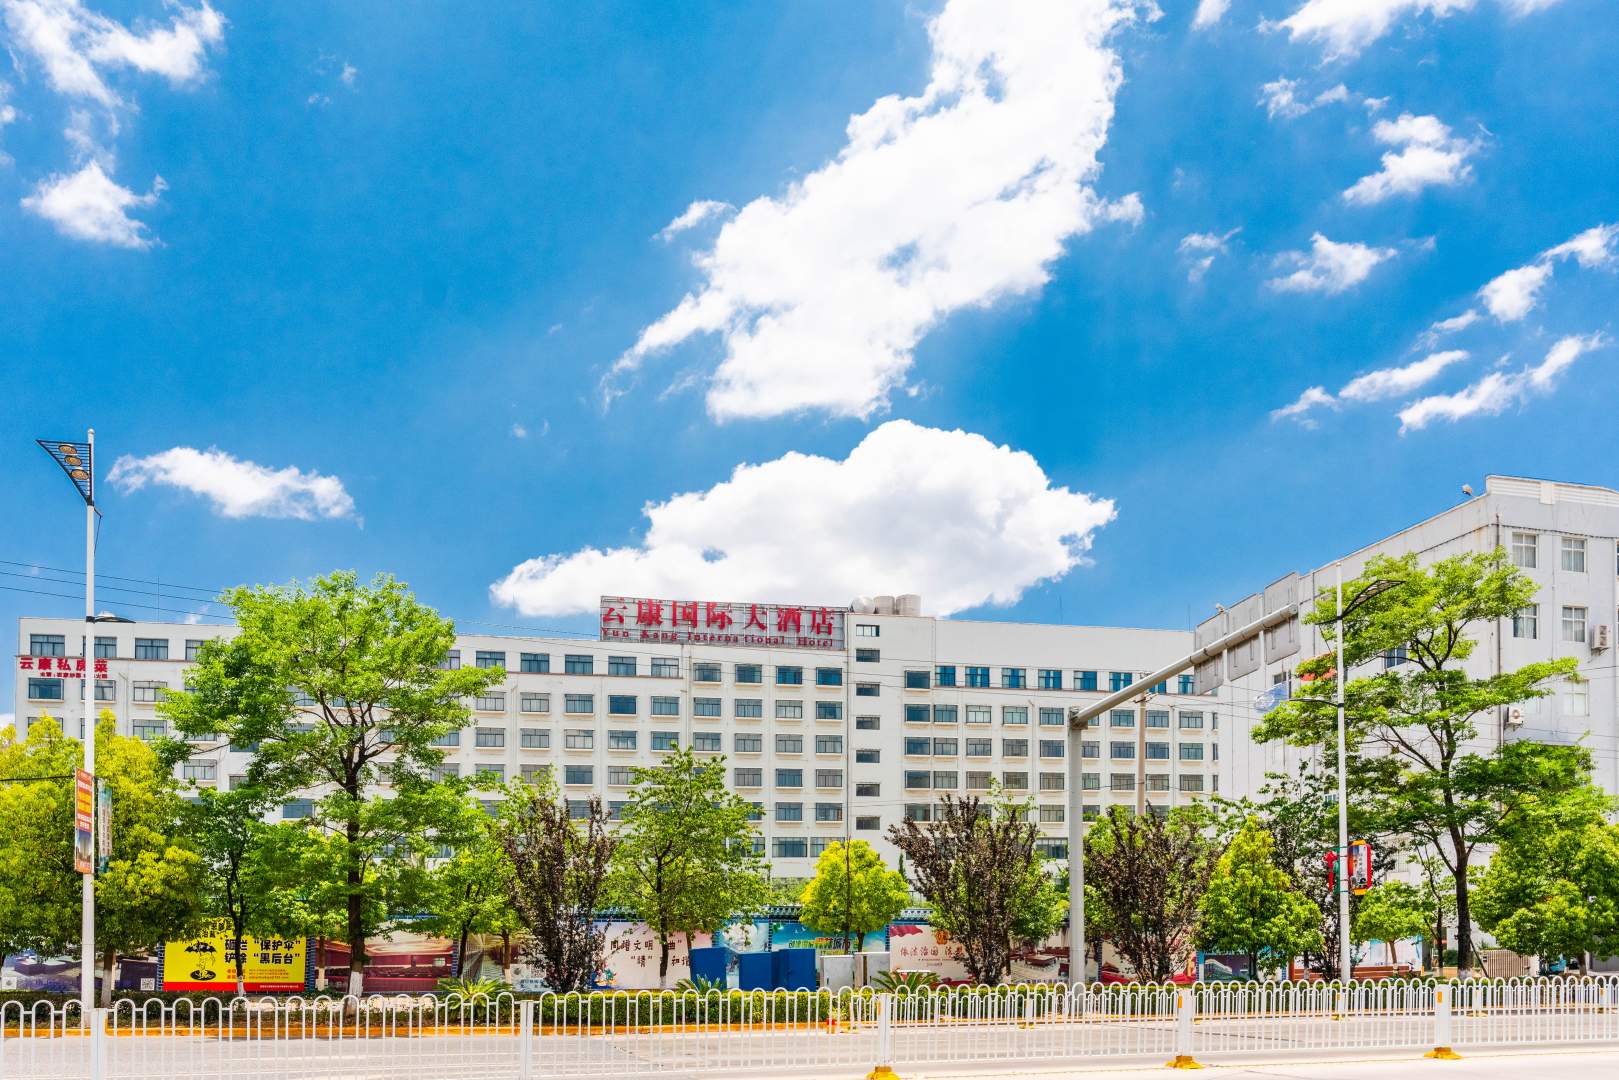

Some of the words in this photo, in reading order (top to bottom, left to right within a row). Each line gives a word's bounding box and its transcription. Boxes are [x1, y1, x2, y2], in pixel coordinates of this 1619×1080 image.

[602, 598, 835, 636] 云康国际大酒店
[602, 627, 629, 638] Yun
[797, 637, 833, 648] Hotel
[19, 657, 108, 672] 云康私房菜
